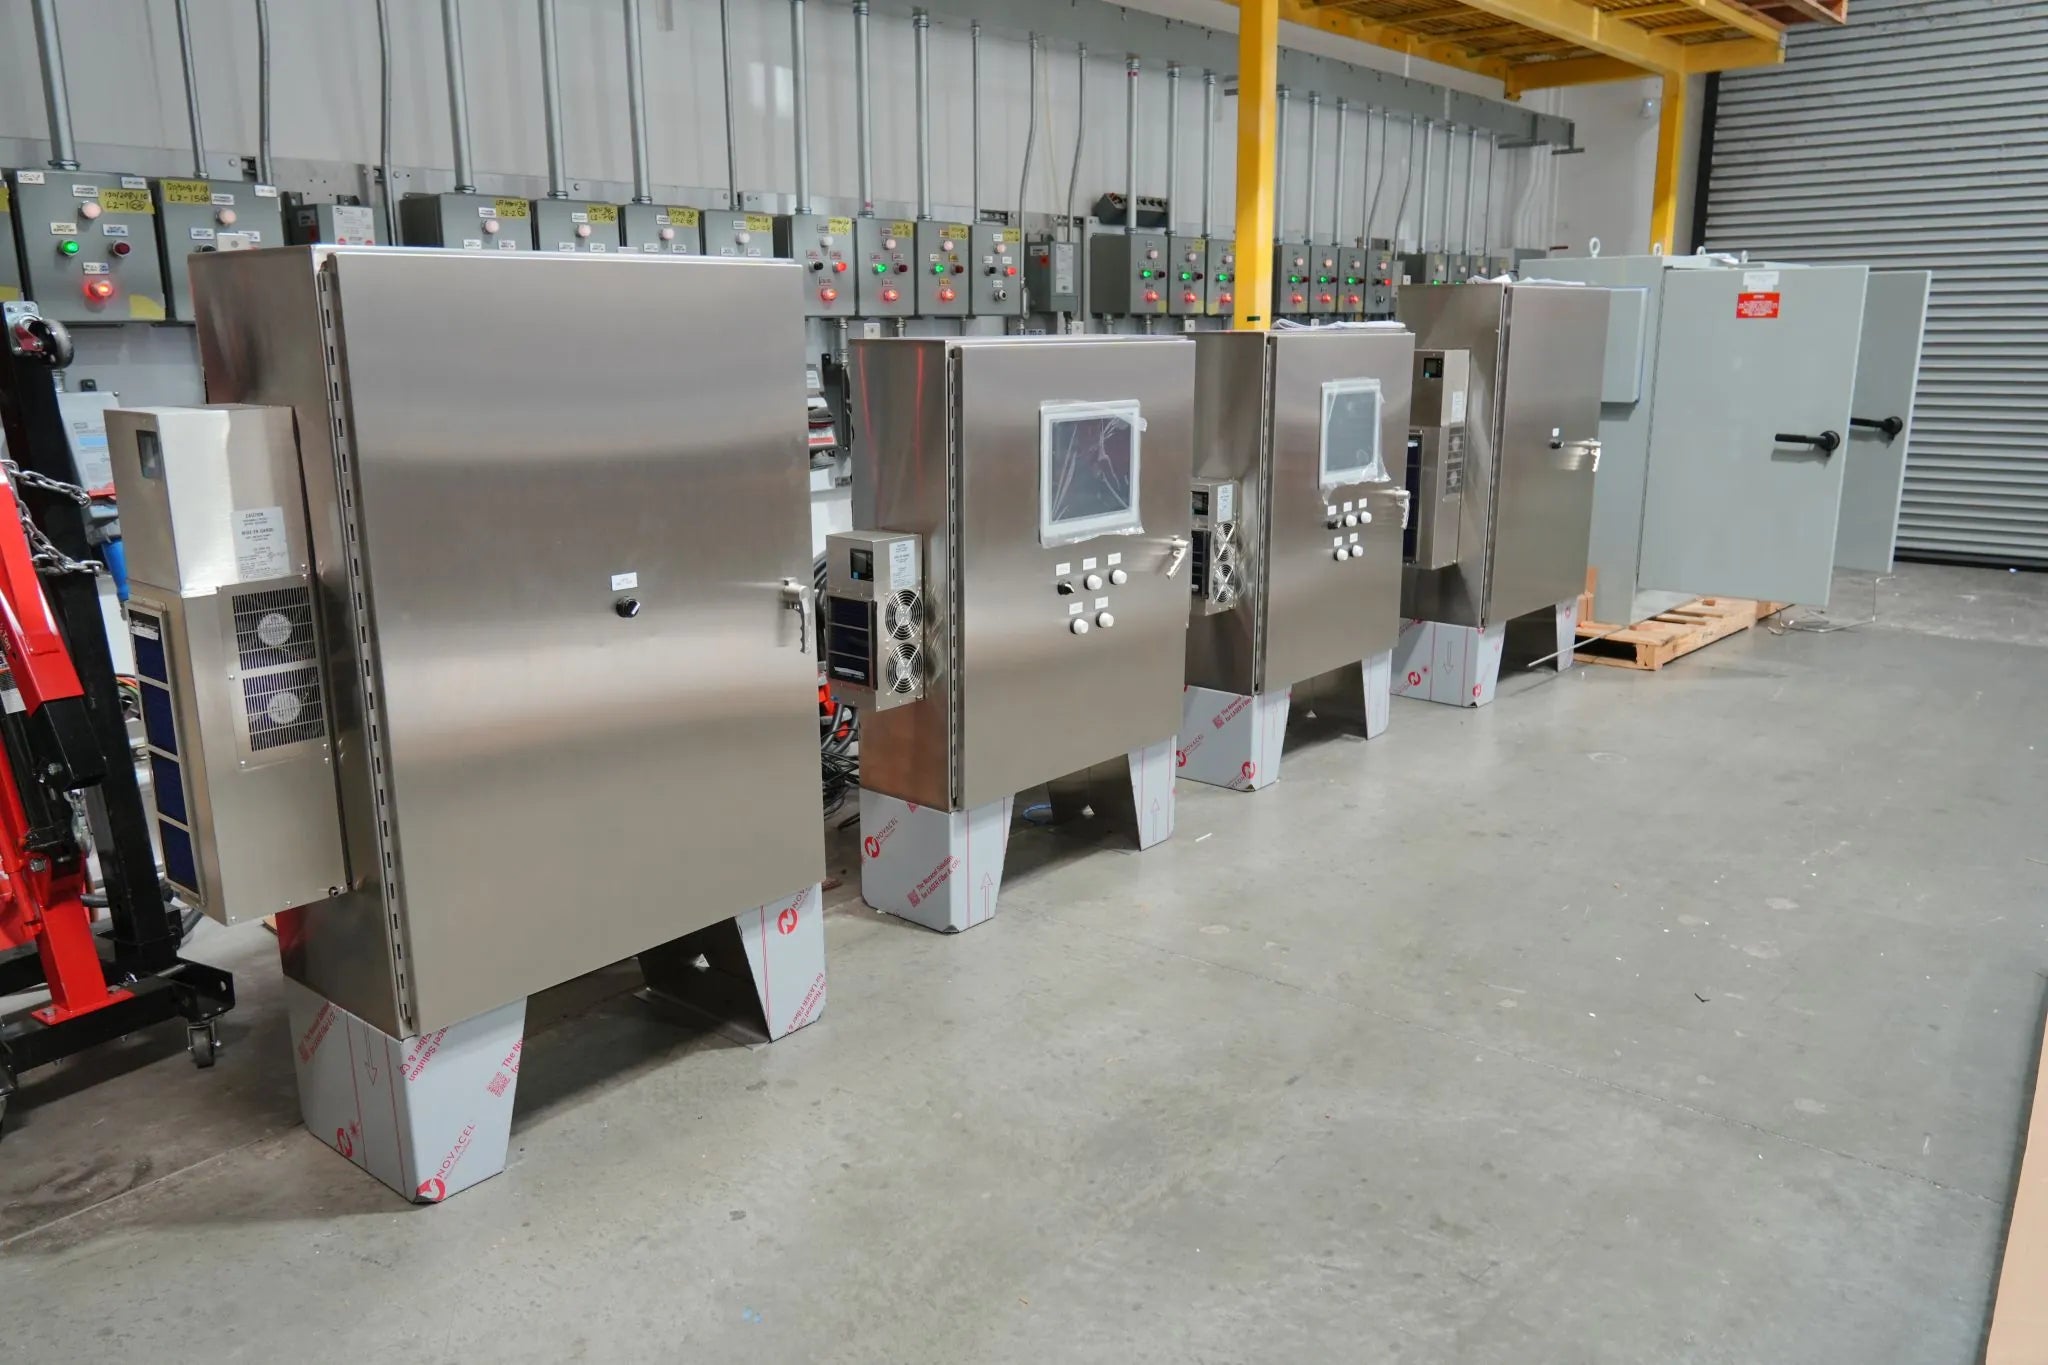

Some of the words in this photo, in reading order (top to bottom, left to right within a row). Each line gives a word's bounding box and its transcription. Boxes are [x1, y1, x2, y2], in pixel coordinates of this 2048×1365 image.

[433, 1026, 449, 1046] acel
[408, 1045, 436, 1082] Solution
[501, 1052, 516, 1068] The
[436, 1124, 476, 1178] NOVACEL
